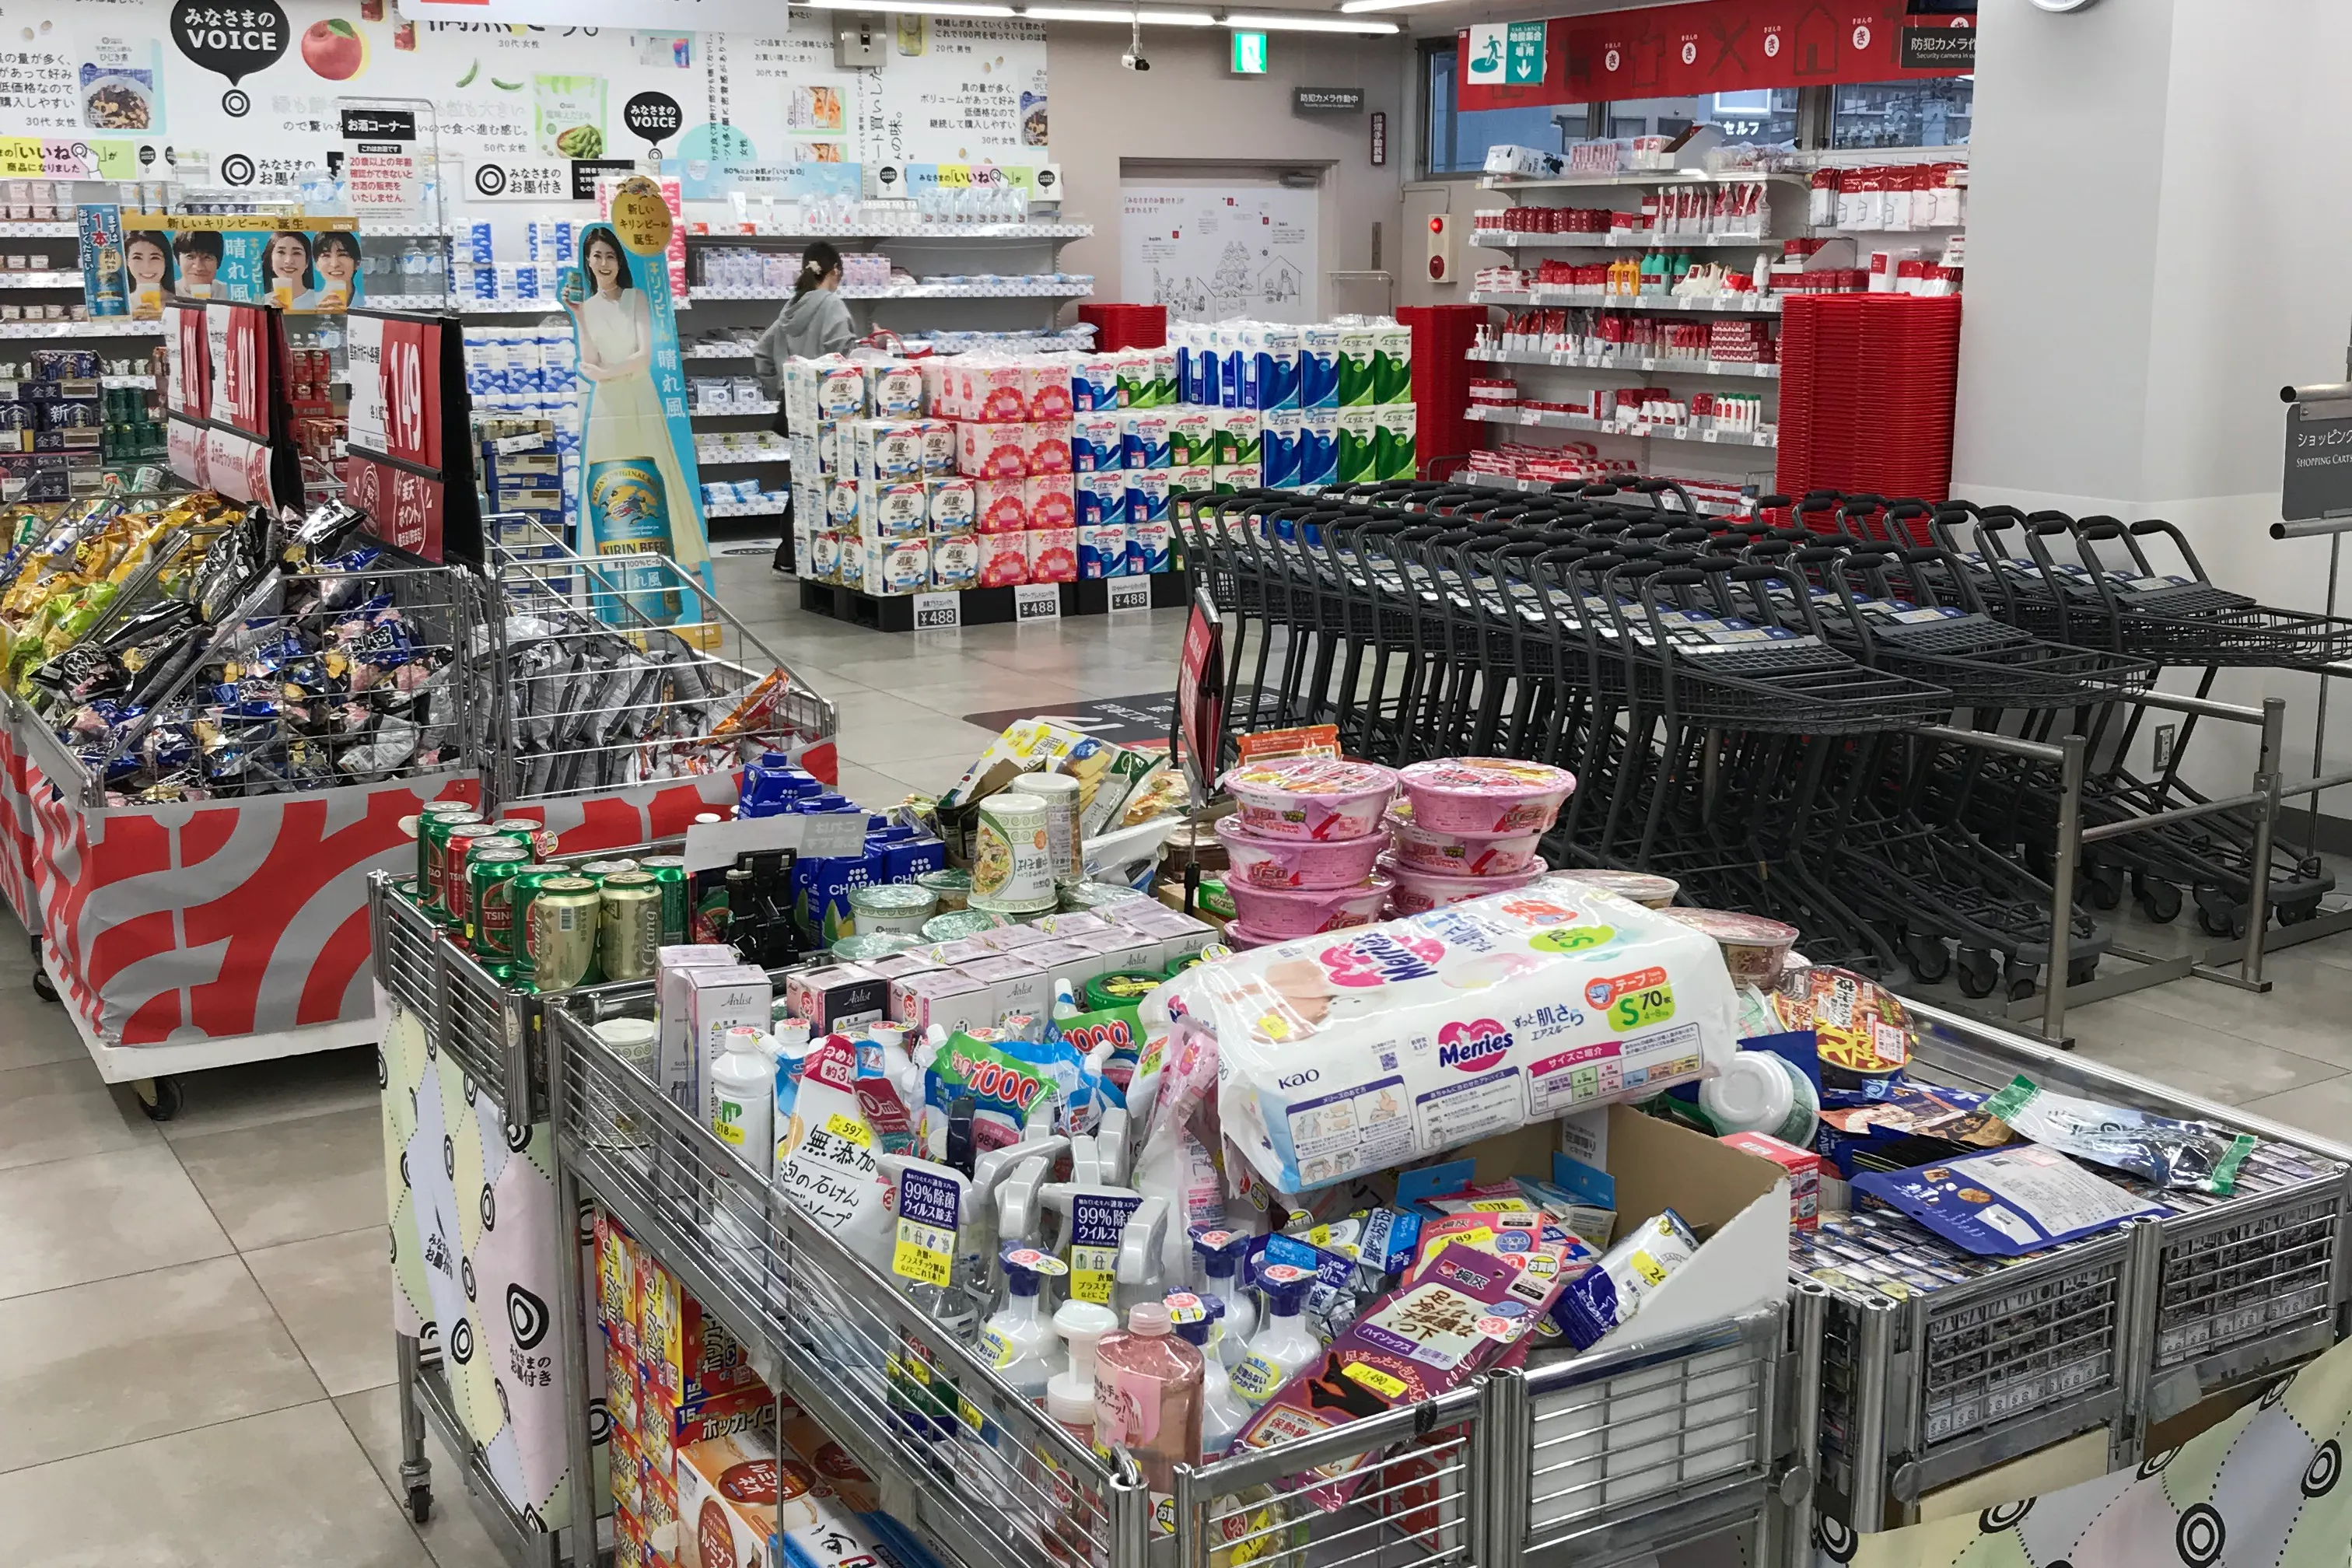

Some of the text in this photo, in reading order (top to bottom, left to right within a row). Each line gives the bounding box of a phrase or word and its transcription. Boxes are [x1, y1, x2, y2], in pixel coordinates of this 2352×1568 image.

[185, 8, 275, 27] みなさまの
[187, 30, 278, 51] VOICE
[499, 40, 540, 49] 30代 女性
[1768, 37, 1776, 54] き
[1857, 29, 1867, 47] き
[957, 45, 971, 54] 男性
[1685, 45, 1693, 61] き
[1916, 51, 1939, 61] Security
[1608, 53, 1617, 68] き
[920, 95, 1016, 105] ボリュームがあって好み
[1300, 93, 1359, 103] 防犯カメラ作動中
[631, 105, 676, 116] みなさまの
[964, 108, 1016, 117] 低価格なので
[26, 117, 78, 128] 30代 女性
[348, 118, 410, 132] お酒コーナー
[632, 117, 677, 128] VOICE
[929, 120, 1017, 129] 継続して購入しやすい
[1723, 121, 1760, 136] セルフ
[484, 143, 527, 152] 50代 女性
[740, 138, 748, 156] 女性
[7, 163, 80, 173] 商品になりました
[259, 159, 315, 170] みなさまの
[349, 157, 412, 167] 20歳以上の年齢
[350, 169, 413, 179] 確認ができないと
[509, 168, 562, 179] みなさまの
[351, 181, 401, 191] お酒の販売を
[510, 180, 562, 194] お墨付き
[352, 194, 407, 203] いたしません。
[628, 204, 654, 215] 新しい
[167, 218, 310, 230] 新しいキリンビール、誕生。
[620, 219, 669, 229] キリンビール
[634, 234, 660, 247] 誕生。
[226, 237, 250, 303] 晴れ風
[649, 262, 671, 342] キリンビール
[657, 350, 688, 418] 晴れ風
[32, 386, 58, 398] 金麦
[50, 404, 68, 422] 新
[1136, 426, 1164, 435] エリエール
[36, 435, 62, 447] 金麦
[2297, 454, 2331, 467] SHOPPING
[41, 485, 64, 495] 金麦
[1091, 480, 1120, 489] エリエール
[1139, 479, 1168, 488] エリエール
[1092, 536, 1121, 544] エリエール
[1134, 533, 1164, 541] エリエール
[604, 540, 668, 555] KIRIN BEER
[640, 909, 658, 971] Chang
[1615, 974, 1647, 992] テープ
[722, 992, 753, 1007] Airlist
[844, 989, 872, 1006] Airlist
[1619, 998, 1639, 1026] S
[1531, 1024, 1571, 1042] エアスルー
[1439, 1031, 1514, 1069] Merries
[1548, 1048, 1604, 1069] サイズご紹介
[802, 1125, 876, 1173] 無添加
[781, 1159, 860, 1207] 泡の石けん
[905, 1181, 956, 1209] 99%除菌
[904, 1199, 956, 1223] ウイルス除去
[1079, 1226, 1124, 1241] ウイルス
[900, 1253, 946, 1276] プラスチック製品
[602, 1237, 618, 1326] ホッカイロ
[1453, 1266, 1490, 1291] 桐灰
[1425, 1289, 1468, 1308] 足の
[644, 1276, 658, 1367] ホッカイロ
[1362, 1327, 1417, 1353] ハイソックス
[679, 1408, 696, 1426] 15
[702, 1404, 777, 1440] ホッカイロ
